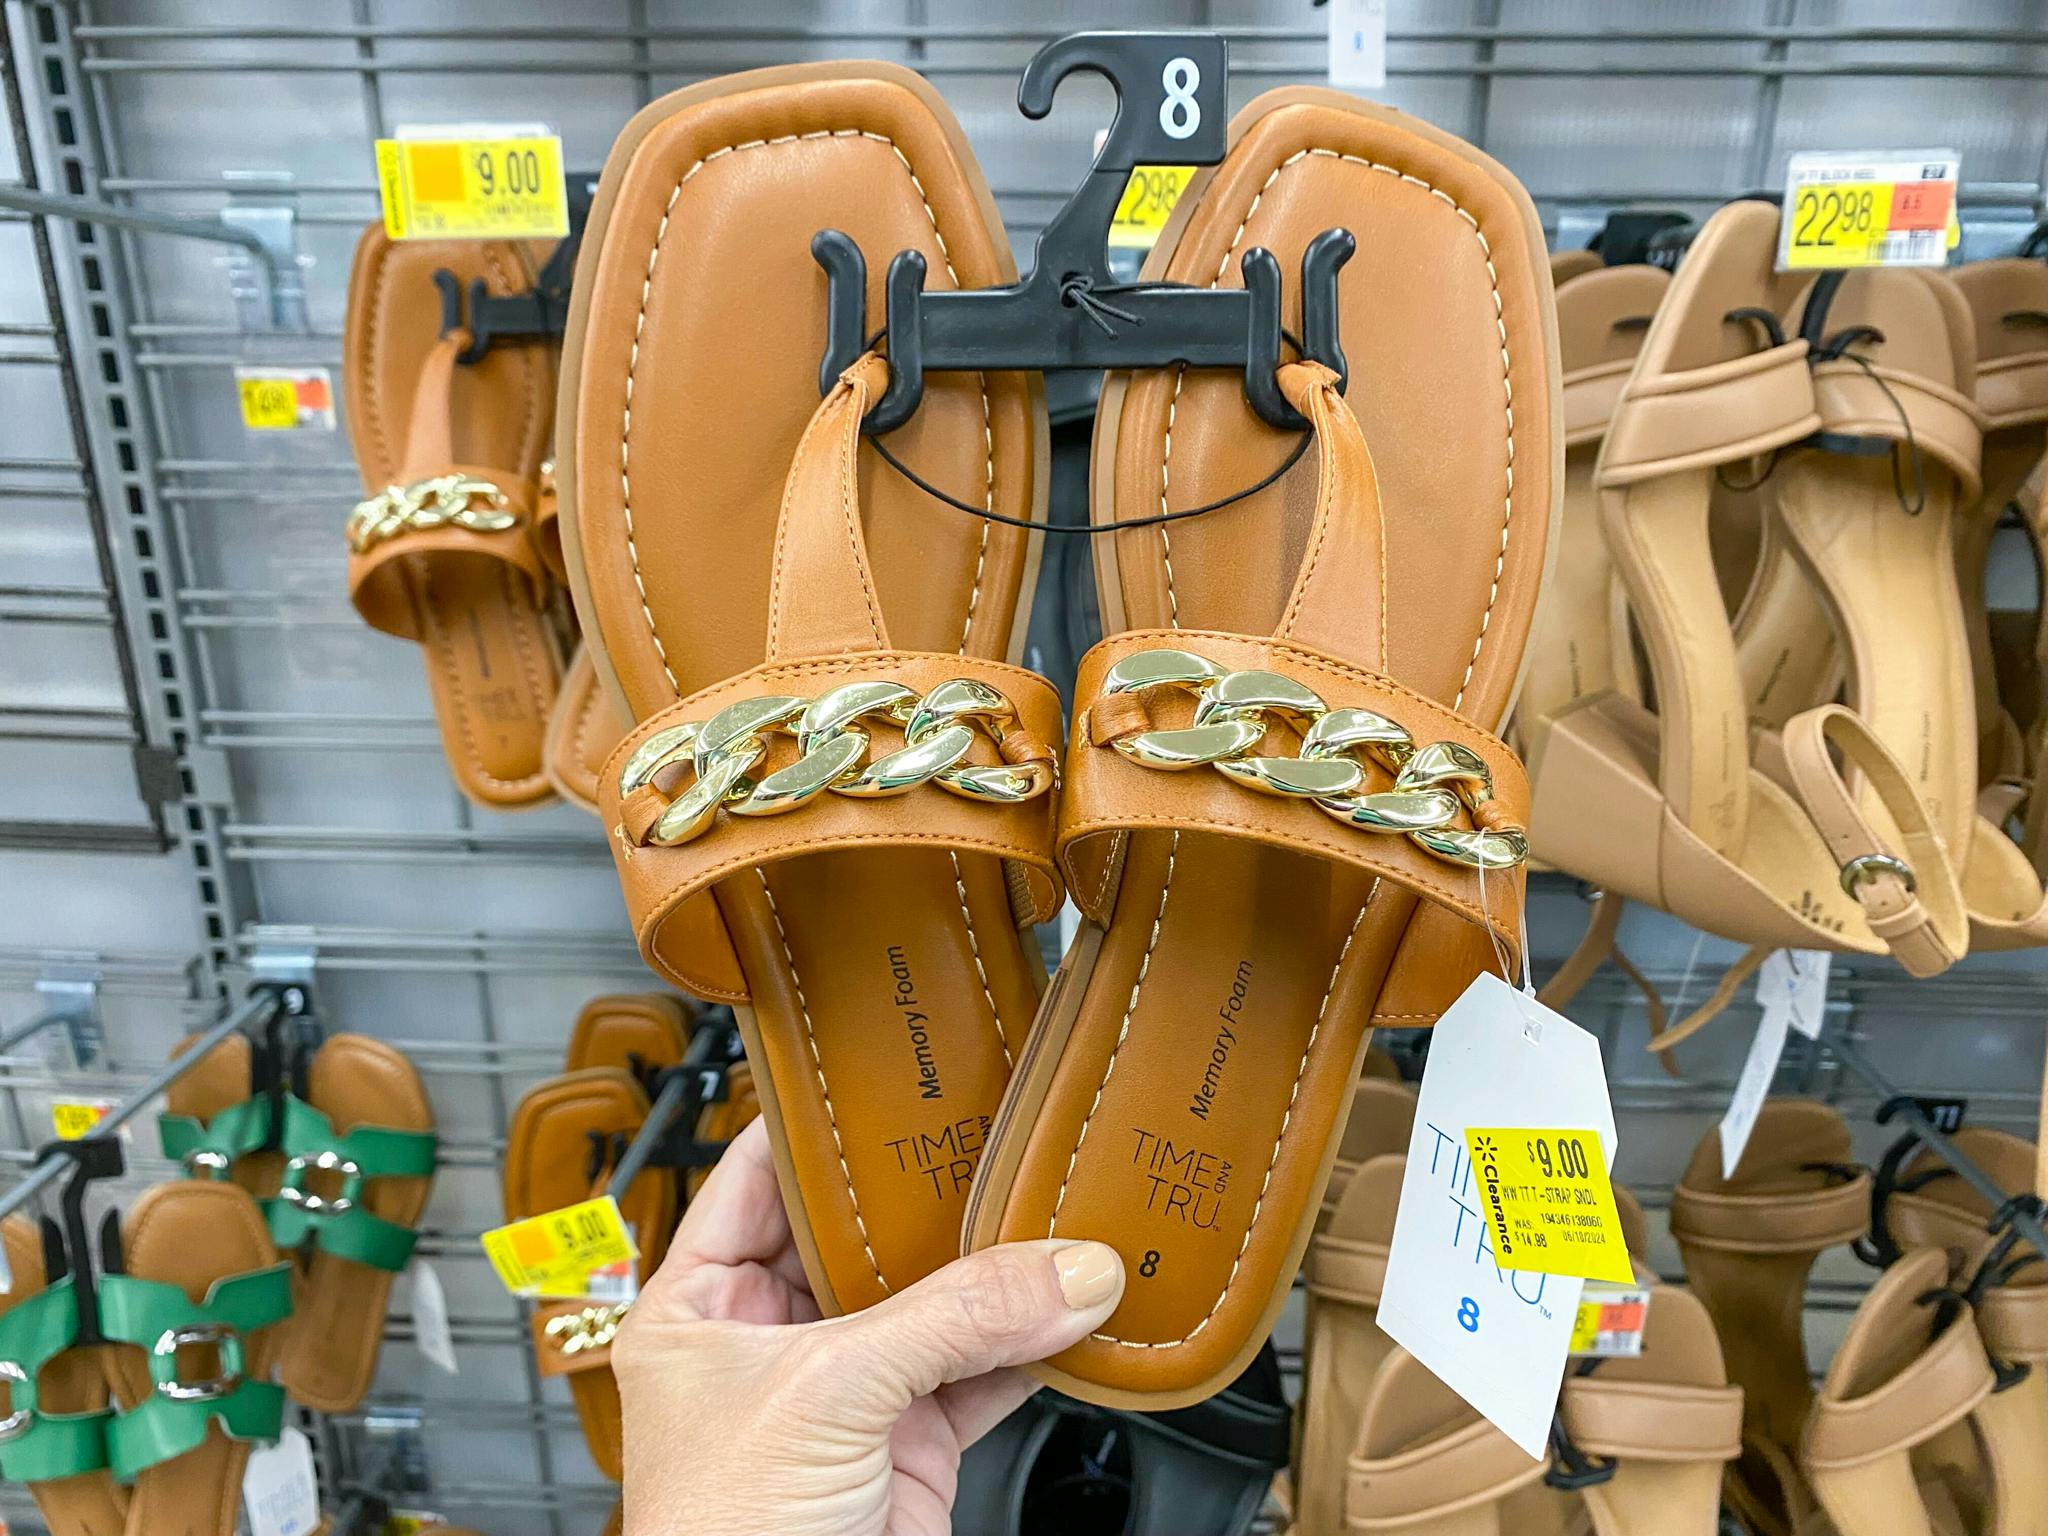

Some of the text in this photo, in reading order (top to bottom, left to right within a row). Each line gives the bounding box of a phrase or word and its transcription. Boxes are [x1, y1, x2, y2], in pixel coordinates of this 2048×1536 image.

[1159, 57, 1200, 140] 8
[887, 945, 943, 1099] Memory Foam
[1190, 960, 1253, 1120] Memory Foam
[699, 1070, 720, 1101] 7
[884, 1119, 981, 1172] TIME
[1131, 1128, 1218, 1189] TIME
[1526, 1138, 1588, 1179] $9.00
[921, 1157, 980, 1200] TR
[1147, 1174, 1220, 1228] TRU
[1214, 1160, 1232, 1194] AND
[1502, 1186, 1517, 1200] WW
[1574, 1188, 1597, 1206] SNDL
[1484, 1165, 1512, 1254] Clearance
[1139, 1250, 1160, 1278] 8
[1456, 1296, 1480, 1333] 8
